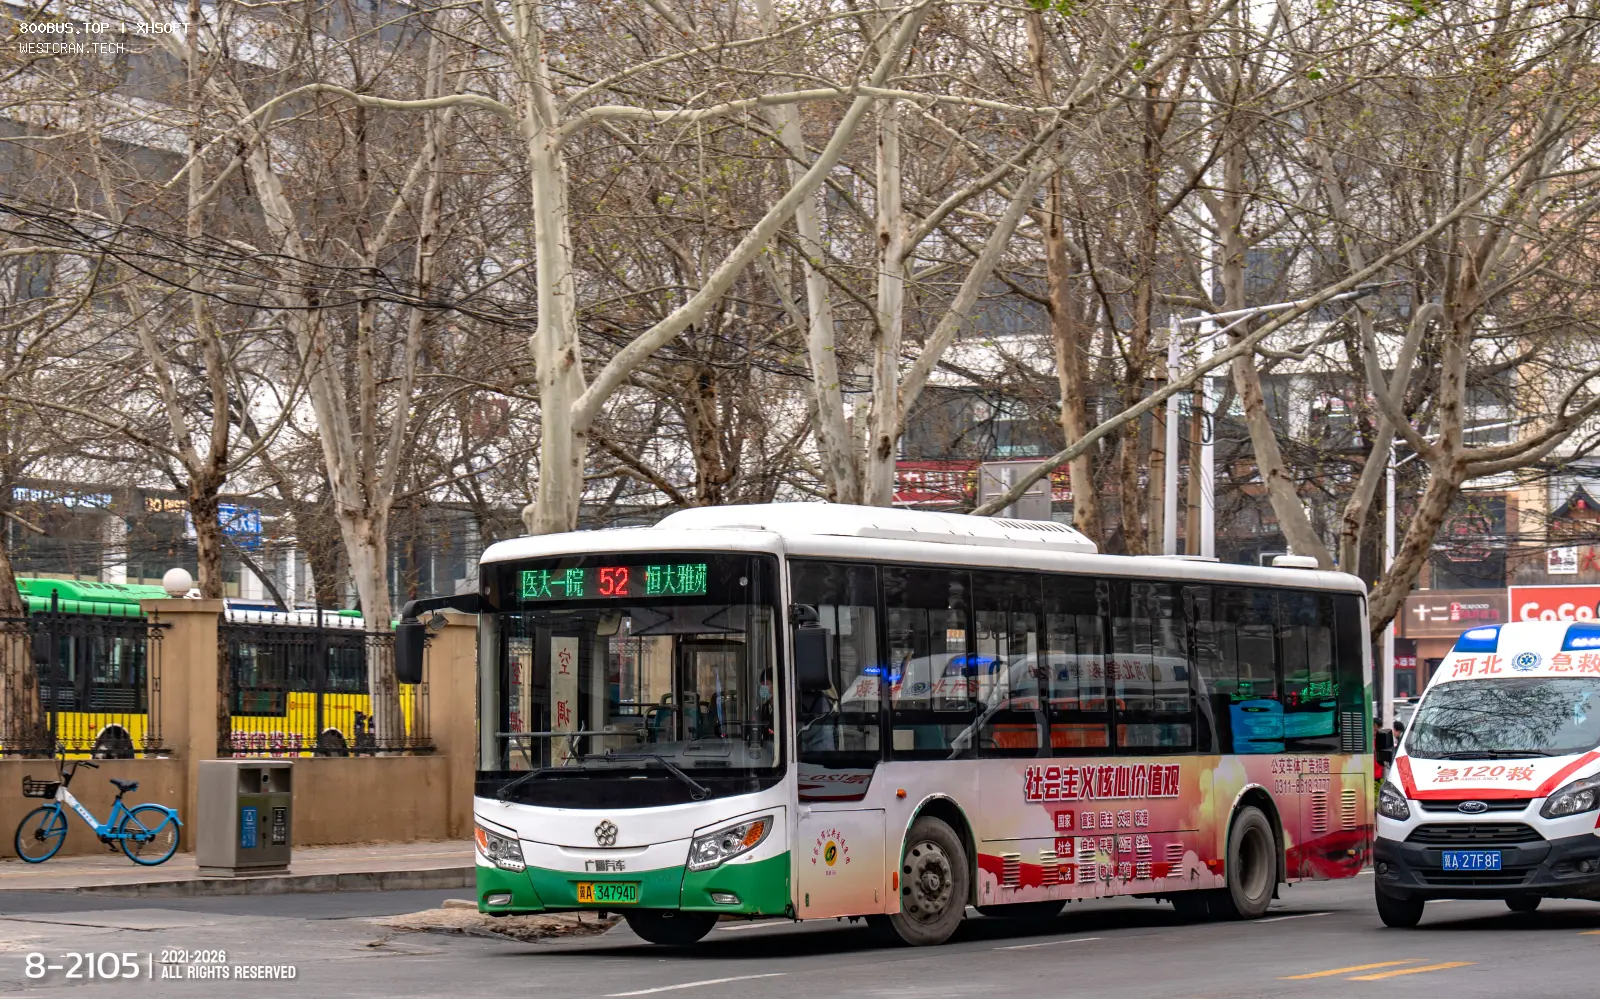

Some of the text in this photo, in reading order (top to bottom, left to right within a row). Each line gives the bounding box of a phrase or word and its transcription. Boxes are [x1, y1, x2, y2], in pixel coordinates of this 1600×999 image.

[522, 563, 708, 598] 医大一院 52 恒大雅苑
[1519, 601, 1594, 623] CoCo
[1452, 652, 1600, 678] 河北 急救
[1270, 757, 1330, 774] 公交车体广告招商
[1025, 763, 1182, 801] 社会主义核心价值观
[1057, 814, 1072, 829] 国家
[1080, 811, 1096, 829] 富强
[1099, 811, 1114, 828] 民主
[1117, 810, 1131, 827] 文明
[1057, 839, 1072, 855] 社会
